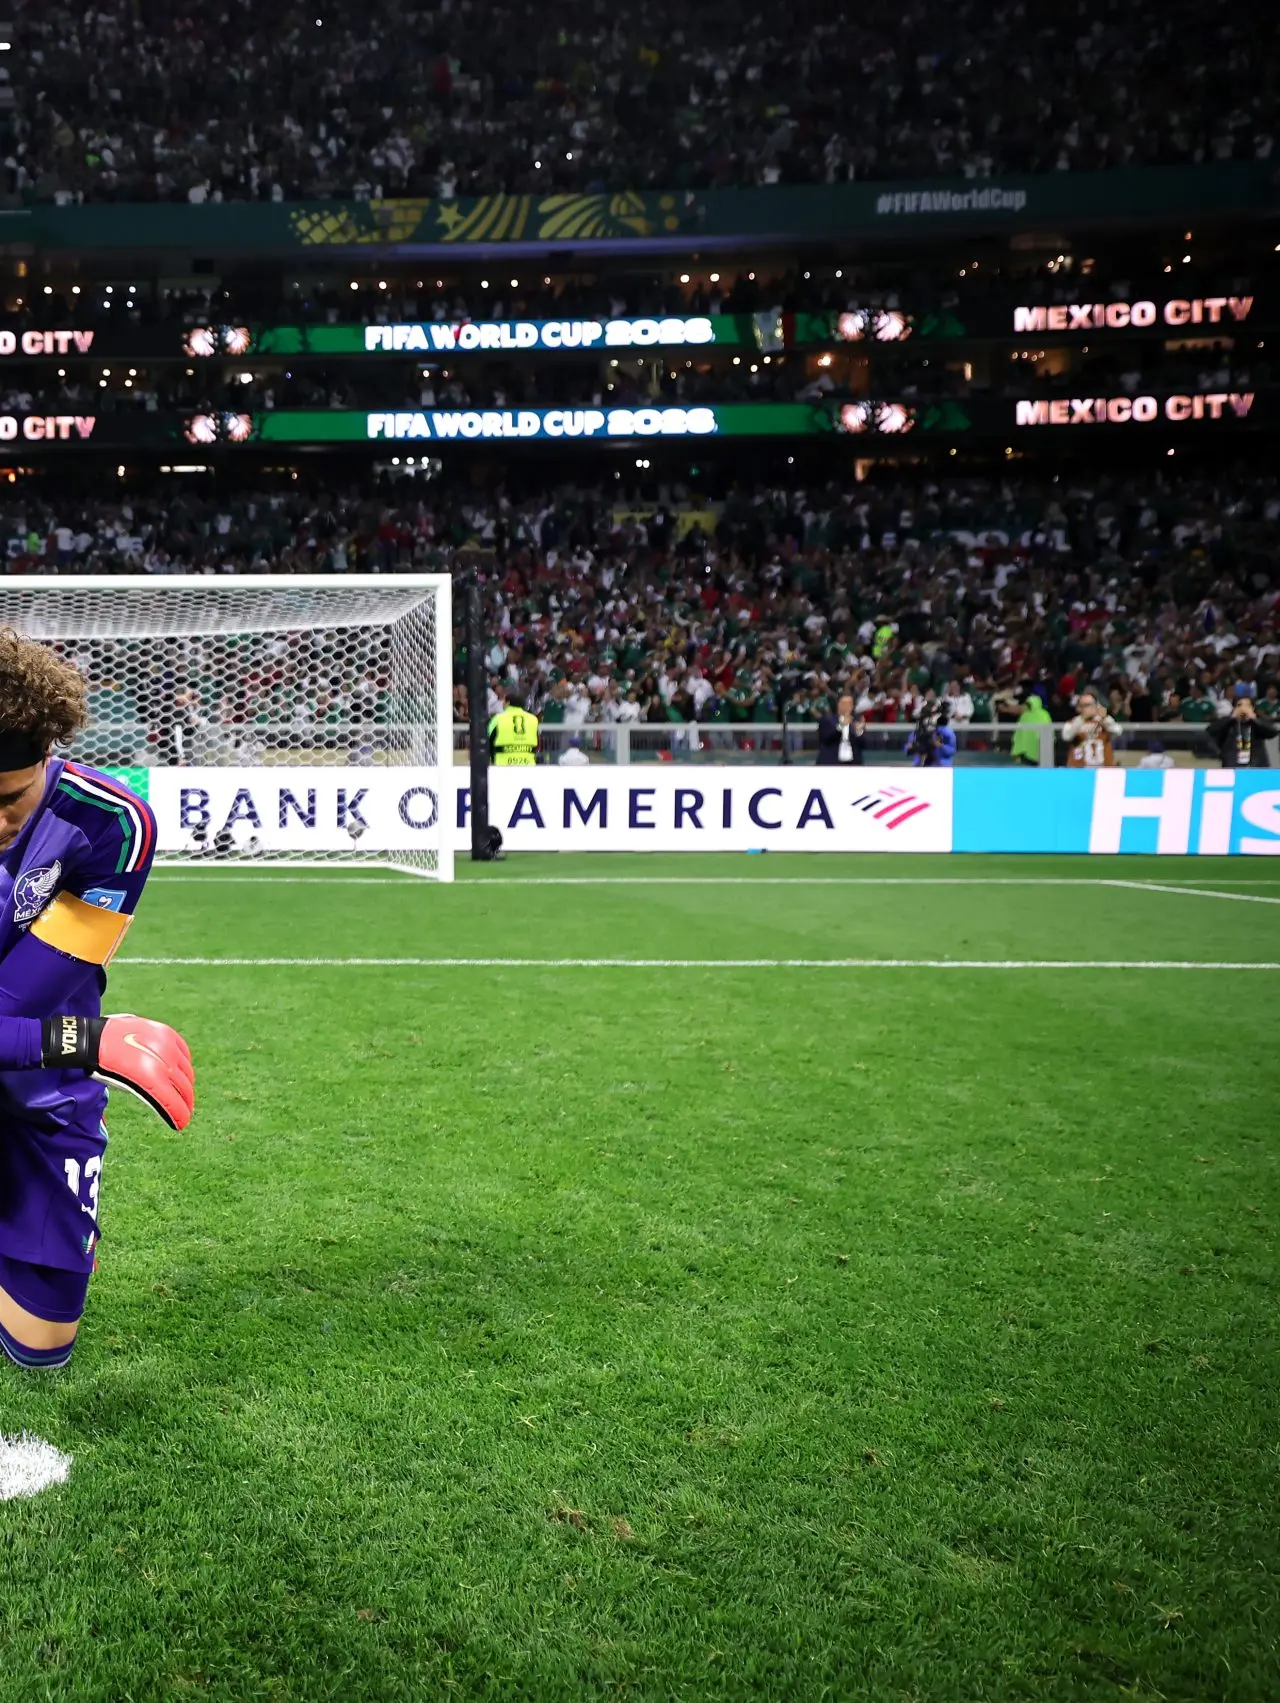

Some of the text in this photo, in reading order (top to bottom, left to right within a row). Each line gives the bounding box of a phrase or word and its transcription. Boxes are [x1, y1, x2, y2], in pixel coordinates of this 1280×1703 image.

[876, 188, 1028, 214] #FIFAWorldCup
[1013, 296, 1254, 333] MEXICO CITY
[21, 330, 94, 355] CITY
[365, 325, 429, 351] FIFA
[430, 322, 539, 349] WORLD
[540, 321, 603, 348] CUP
[367, 413, 431, 438] FIFA
[432, 411, 541, 438] WORLD
[543, 410, 605, 437] CUP
[1015, 392, 1255, 426] MEXICO CITY
[23, 415, 96, 440] CITY
[179, 787, 370, 830] BANK
[506, 787, 835, 829] AMERICA
[61, 1016, 78, 1055] CHOA
[64, 1155, 101, 1222] 13
